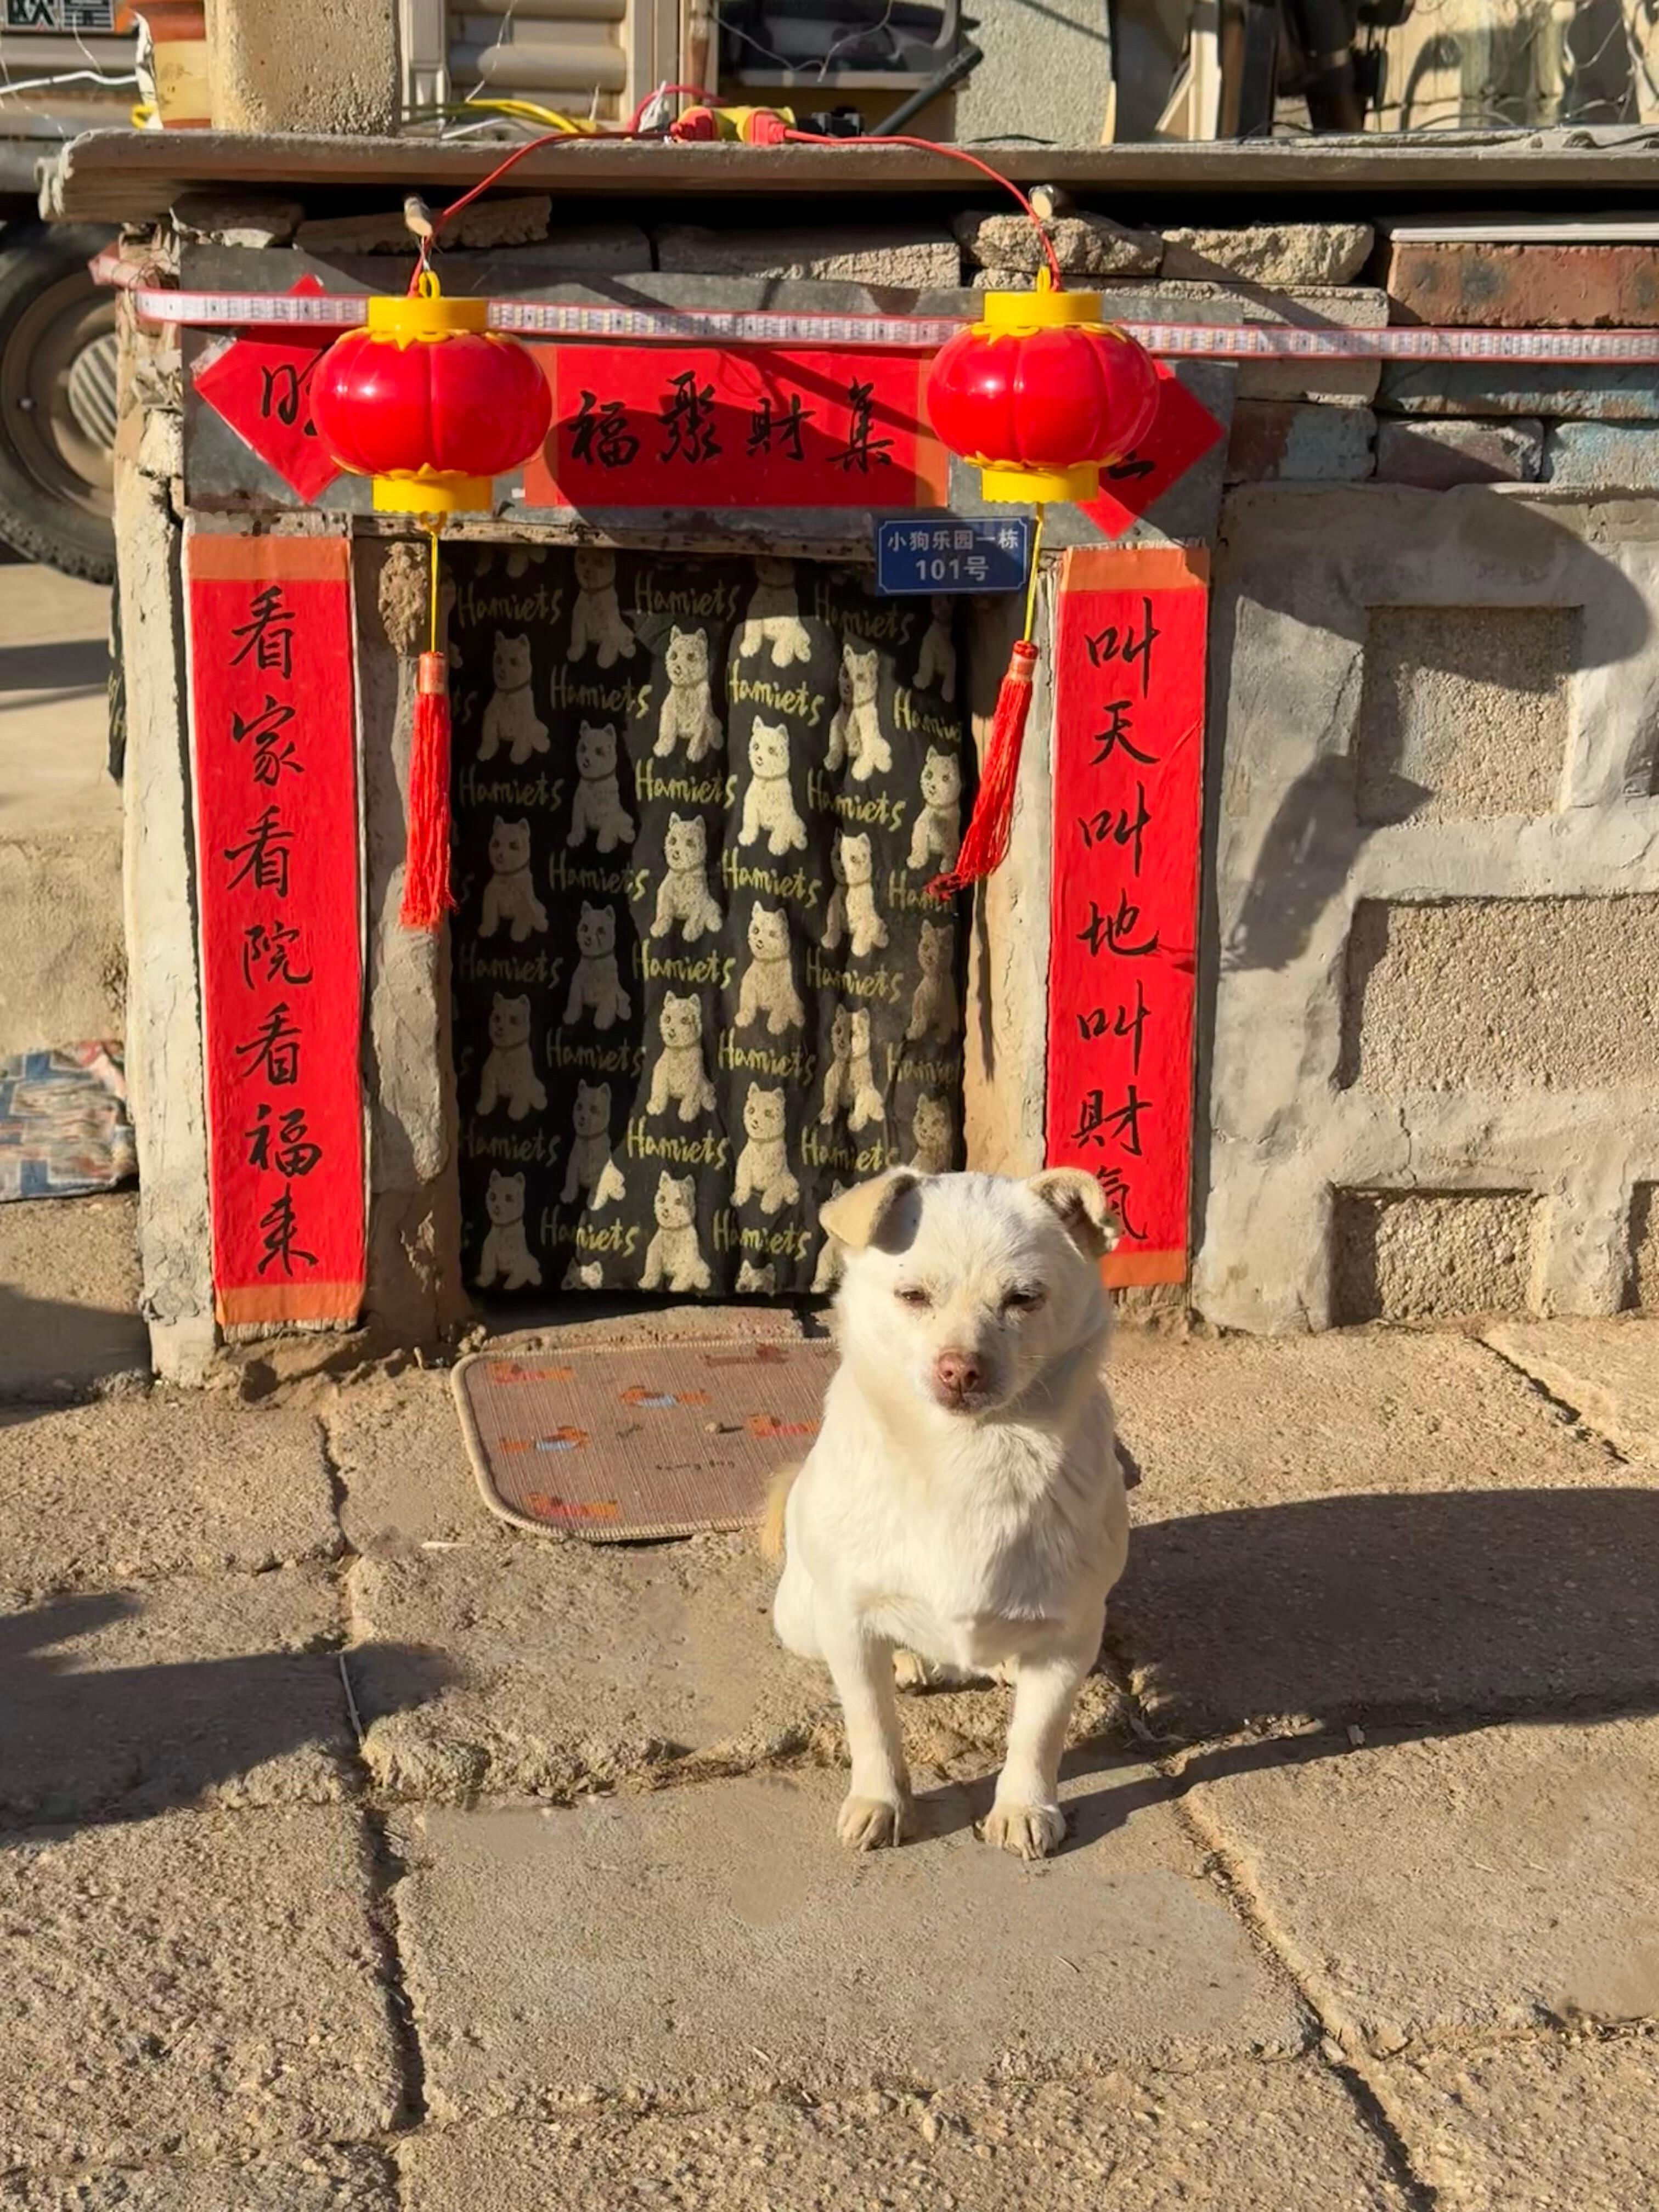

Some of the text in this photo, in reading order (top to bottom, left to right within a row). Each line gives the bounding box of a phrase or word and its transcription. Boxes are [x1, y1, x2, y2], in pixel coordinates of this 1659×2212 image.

[887, 528, 1019, 552] 小狗乐园一栋
[915, 556, 989, 582] 101号
[723, 847, 821, 908] Hamiets
[627, 1116, 730, 1170] Hamiets
